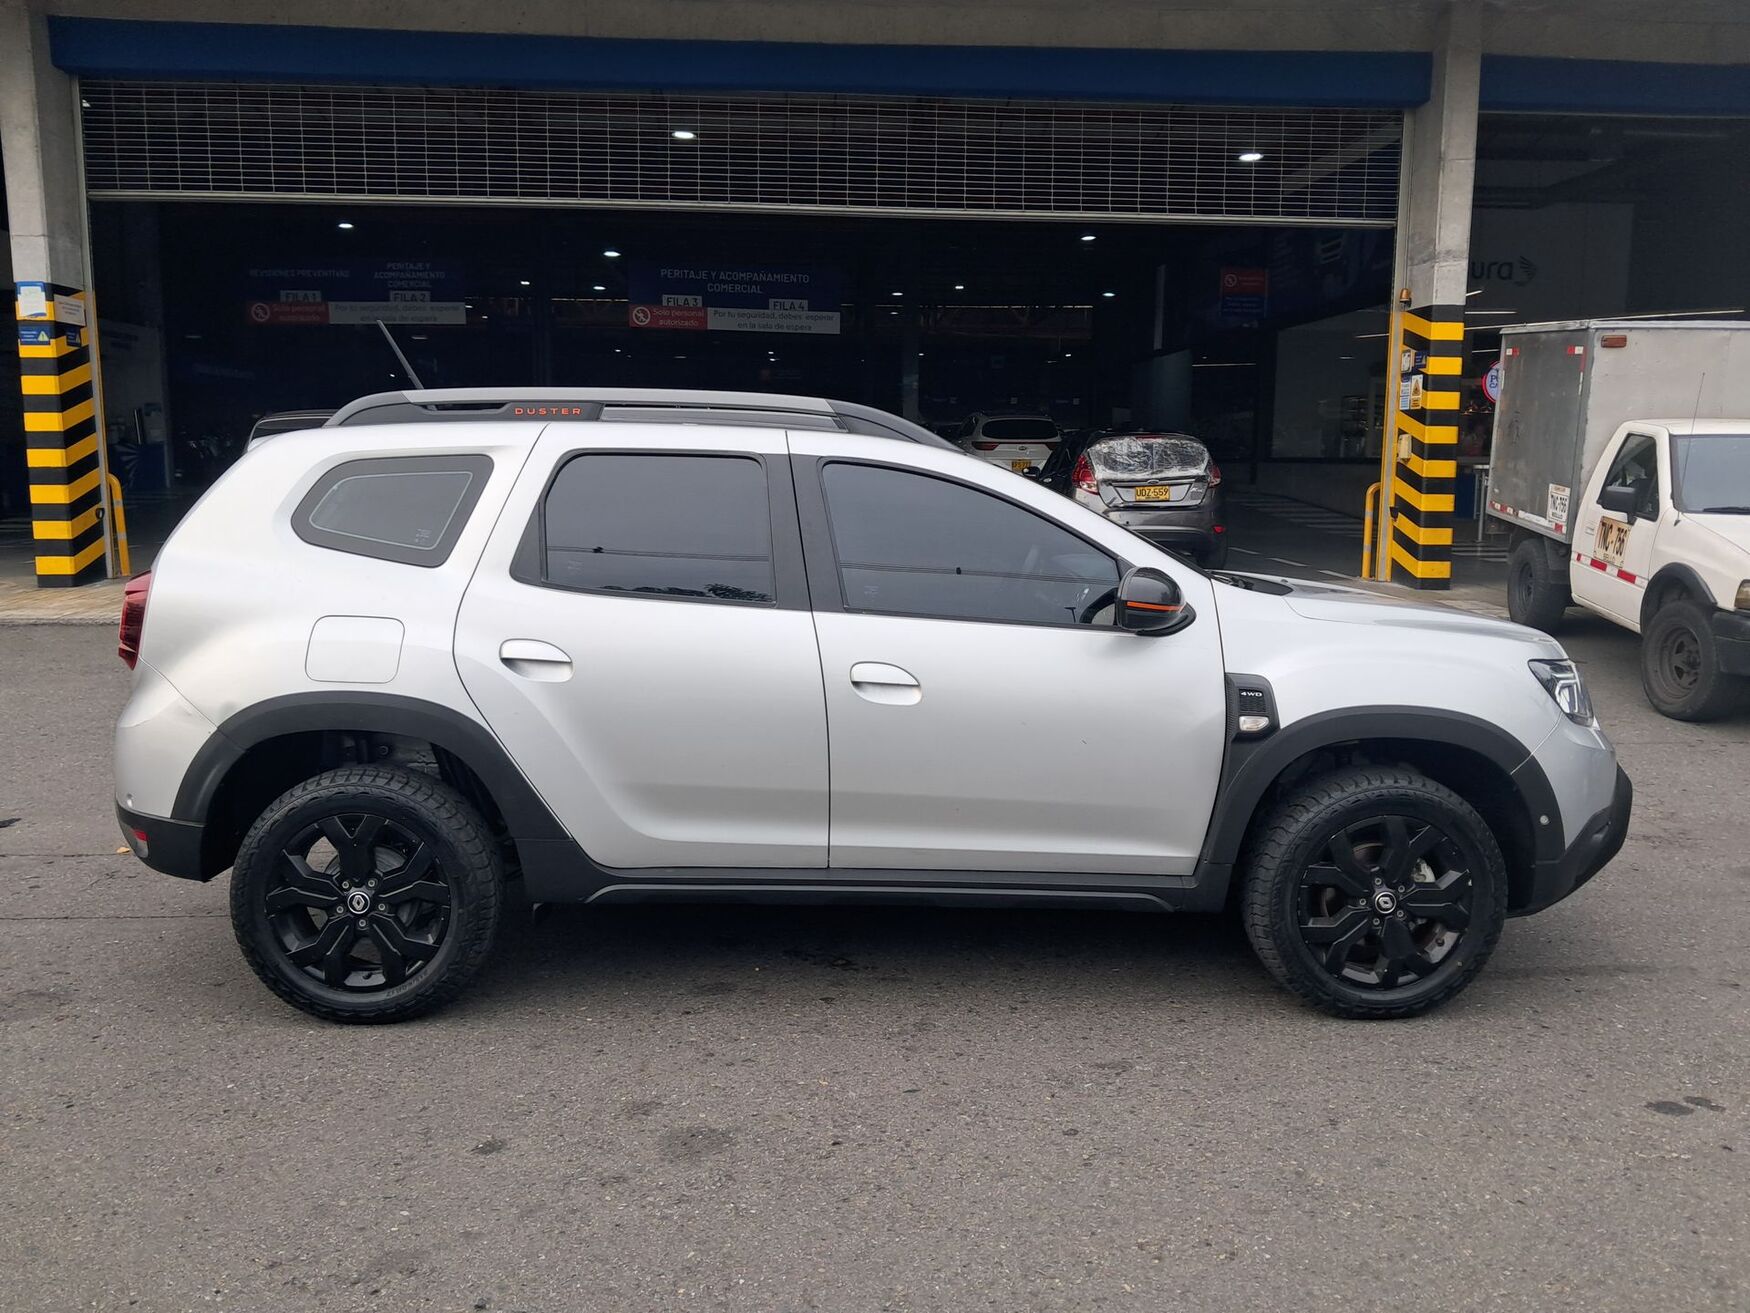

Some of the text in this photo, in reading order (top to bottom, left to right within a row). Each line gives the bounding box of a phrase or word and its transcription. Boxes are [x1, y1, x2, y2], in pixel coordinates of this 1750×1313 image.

[660, 269, 810, 283] PERITAJE Y ACOMPAÑAMIENTO
[707, 283, 763, 294] COMERCIAL
[285, 292, 309, 302] FILA
[393, 292, 417, 302] FILA
[666, 297, 699, 307] FILA 3
[773, 301, 805, 312] FILA 4
[514, 407, 582, 416] DUSTER
